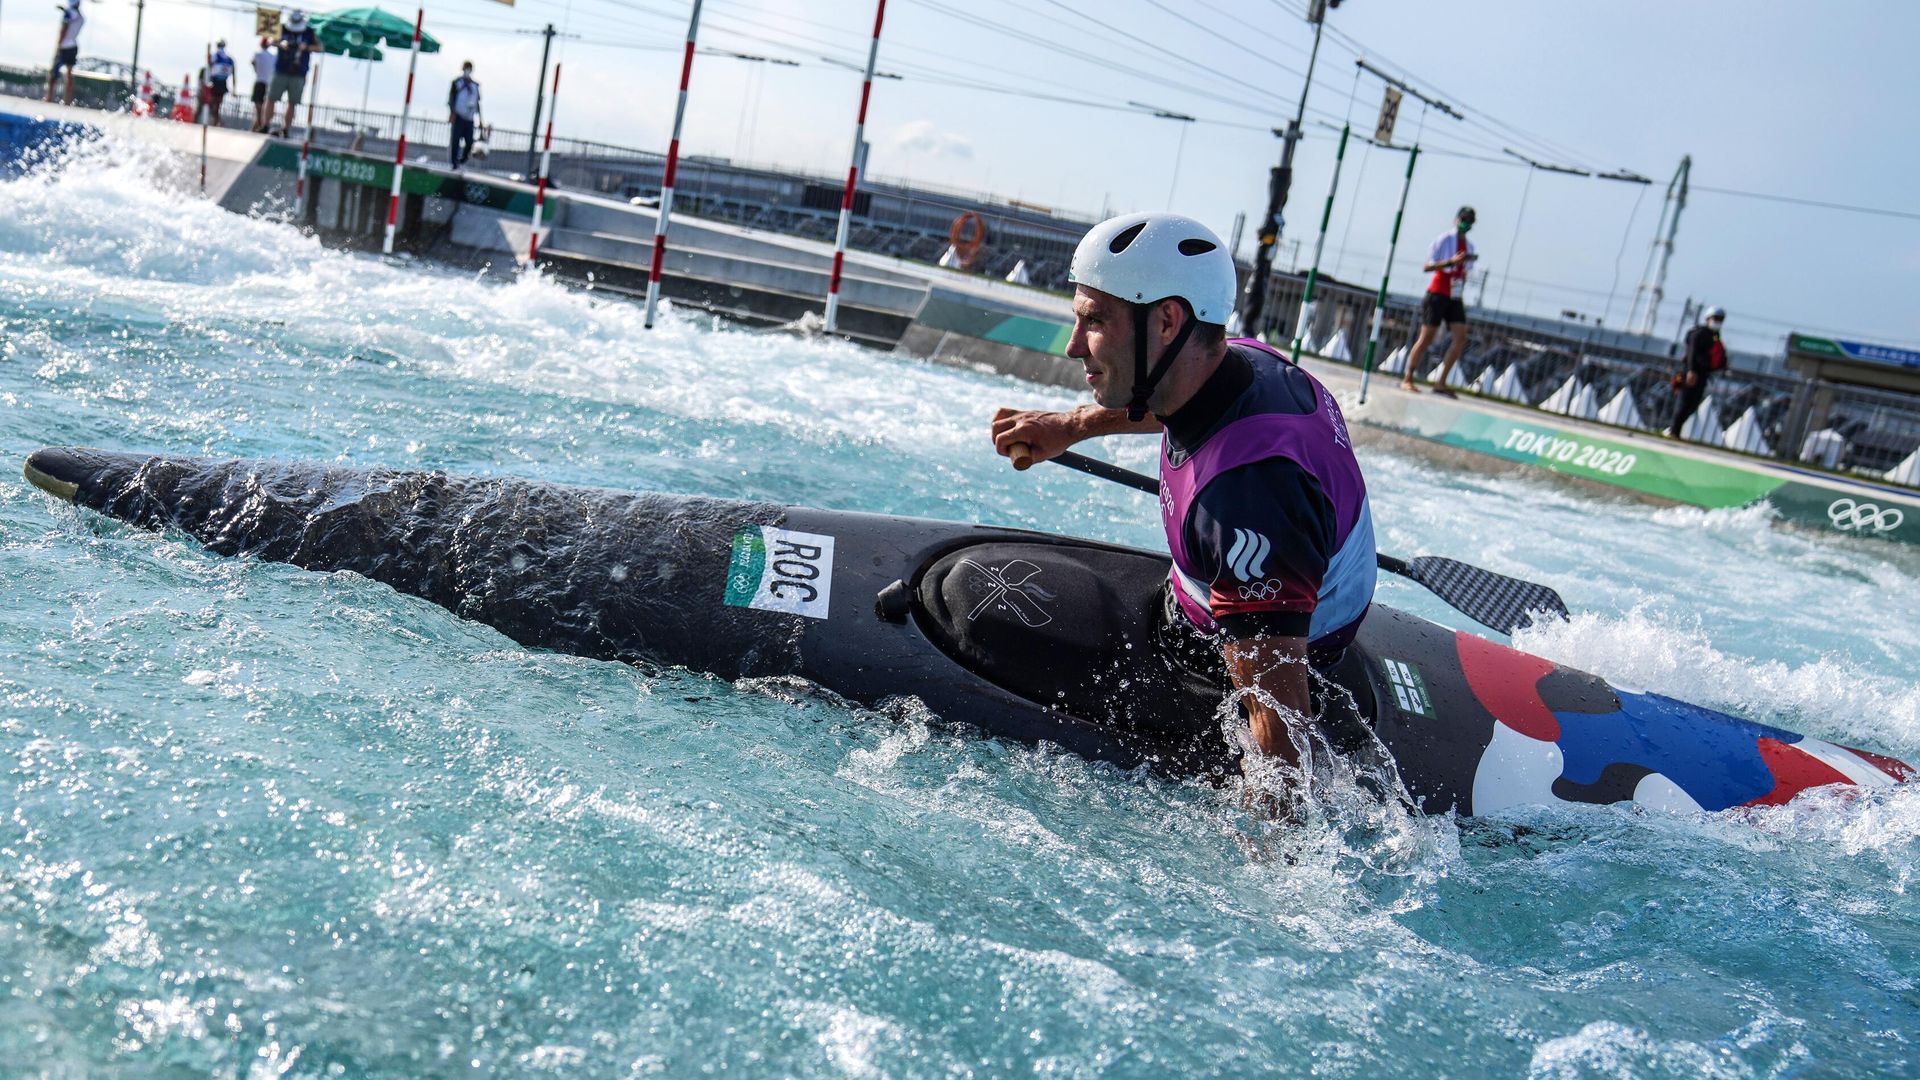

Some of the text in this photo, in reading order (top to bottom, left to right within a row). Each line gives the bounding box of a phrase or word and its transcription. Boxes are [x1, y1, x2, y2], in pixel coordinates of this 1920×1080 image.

[342, 161, 376, 181] 2020
[1503, 428, 1637, 476] TOKYO 2020
[1162, 479, 1175, 517] 2020
[769, 539, 822, 603] ROC
